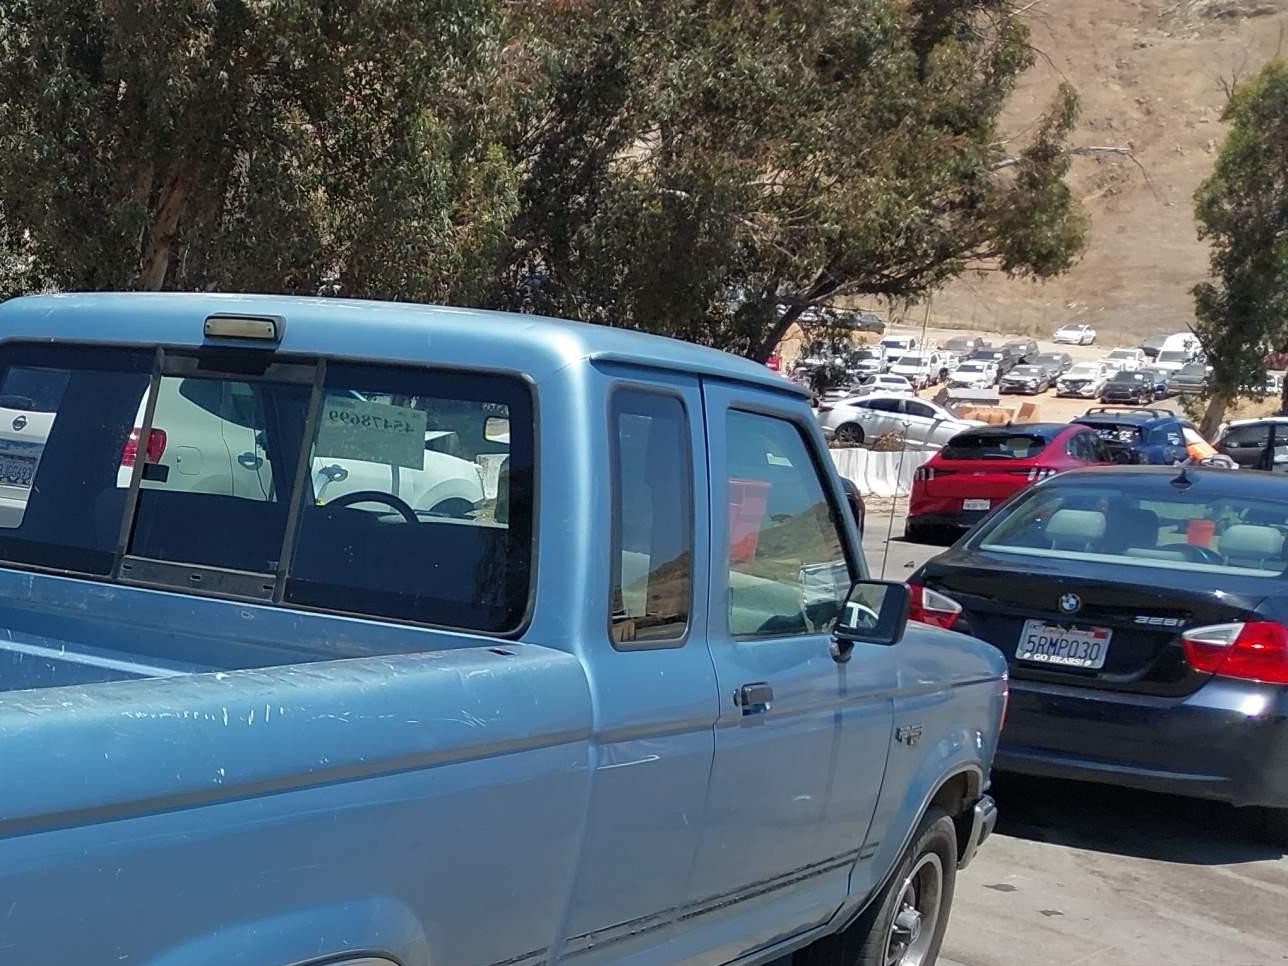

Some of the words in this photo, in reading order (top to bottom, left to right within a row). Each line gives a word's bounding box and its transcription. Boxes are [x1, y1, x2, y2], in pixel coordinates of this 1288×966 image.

[1026, 635, 1100, 661] 5RMP030
[1033, 653, 1048, 662] GO
[1050, 656, 1084, 666] BEARS!
